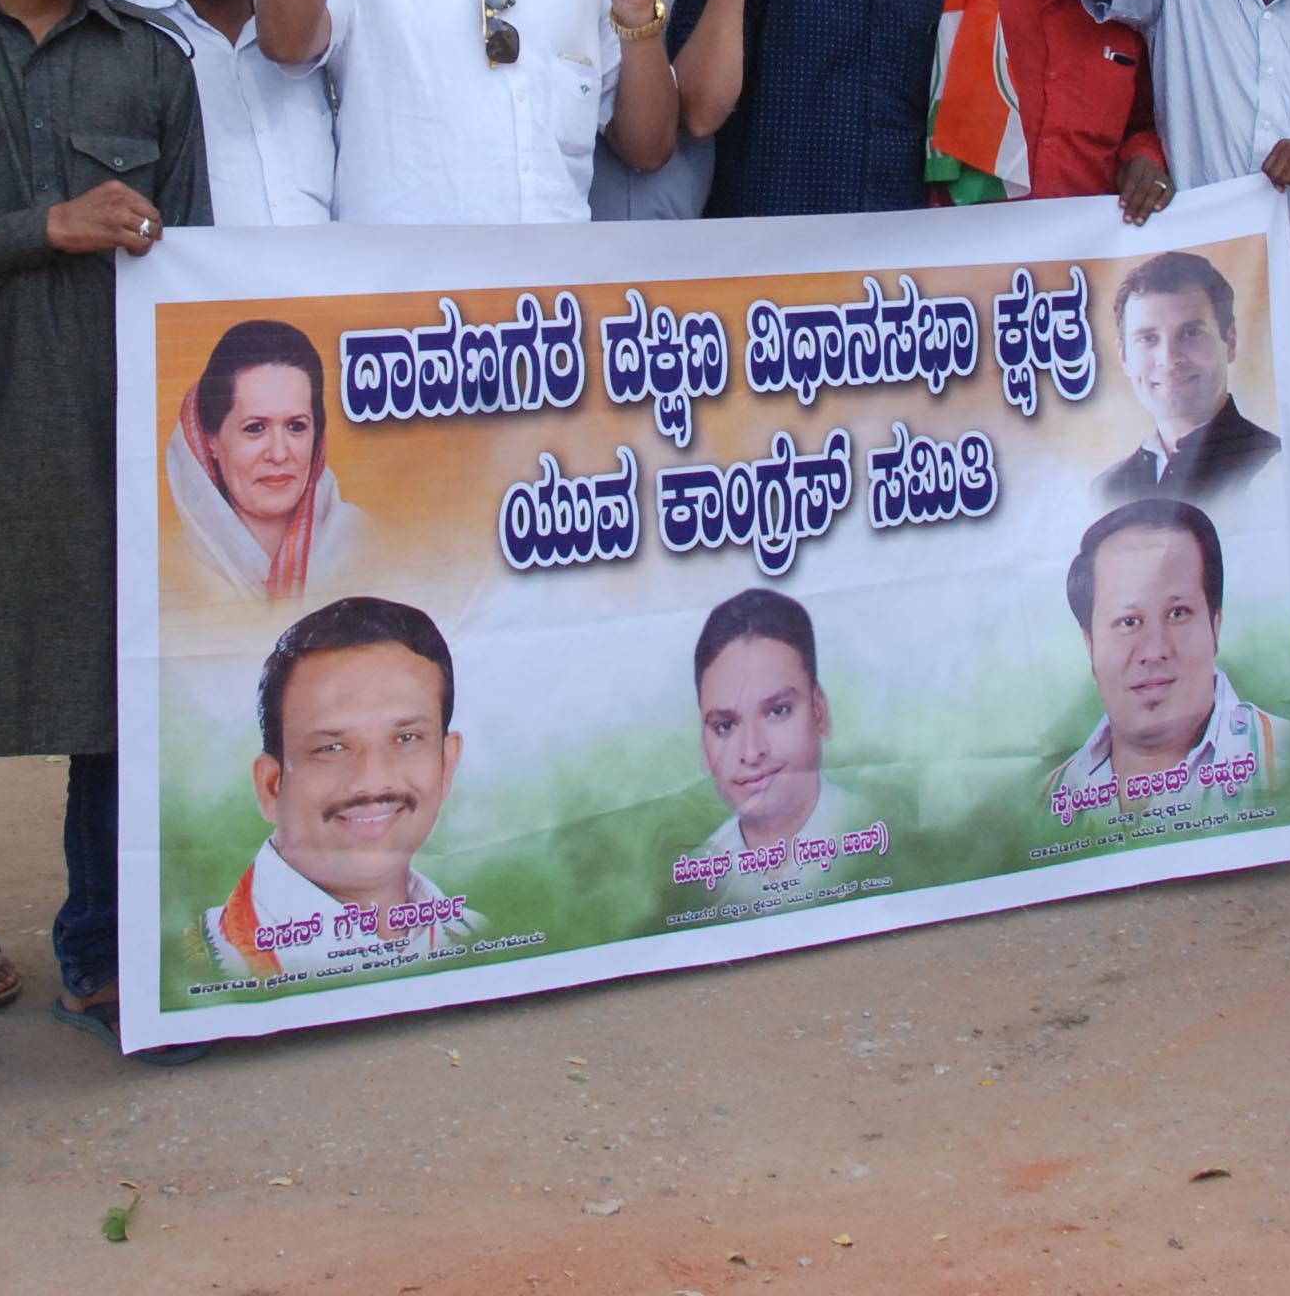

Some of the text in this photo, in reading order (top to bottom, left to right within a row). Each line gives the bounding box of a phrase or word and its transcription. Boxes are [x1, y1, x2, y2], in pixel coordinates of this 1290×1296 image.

[341, 267, 1096, 448] ದಾವಣಗೆರೆ ದಕ್ಷಿಣ ವಿಧಾನಸಭಾ ಕ್ಷೇತ್ರ
[499, 421, 999, 576] ಯುವ ಕಾಂಗ್ರೆಸ್ ಸಮಿತಿ
[1052, 752, 1257, 825] ಸೈಯದ್ ಖಾಲಿದ್ ಅಹ್ಮದ್
[255, 894, 467, 952] ಬಸನ್ ಗೌಡ ಬಾದರ್ಲಿ
